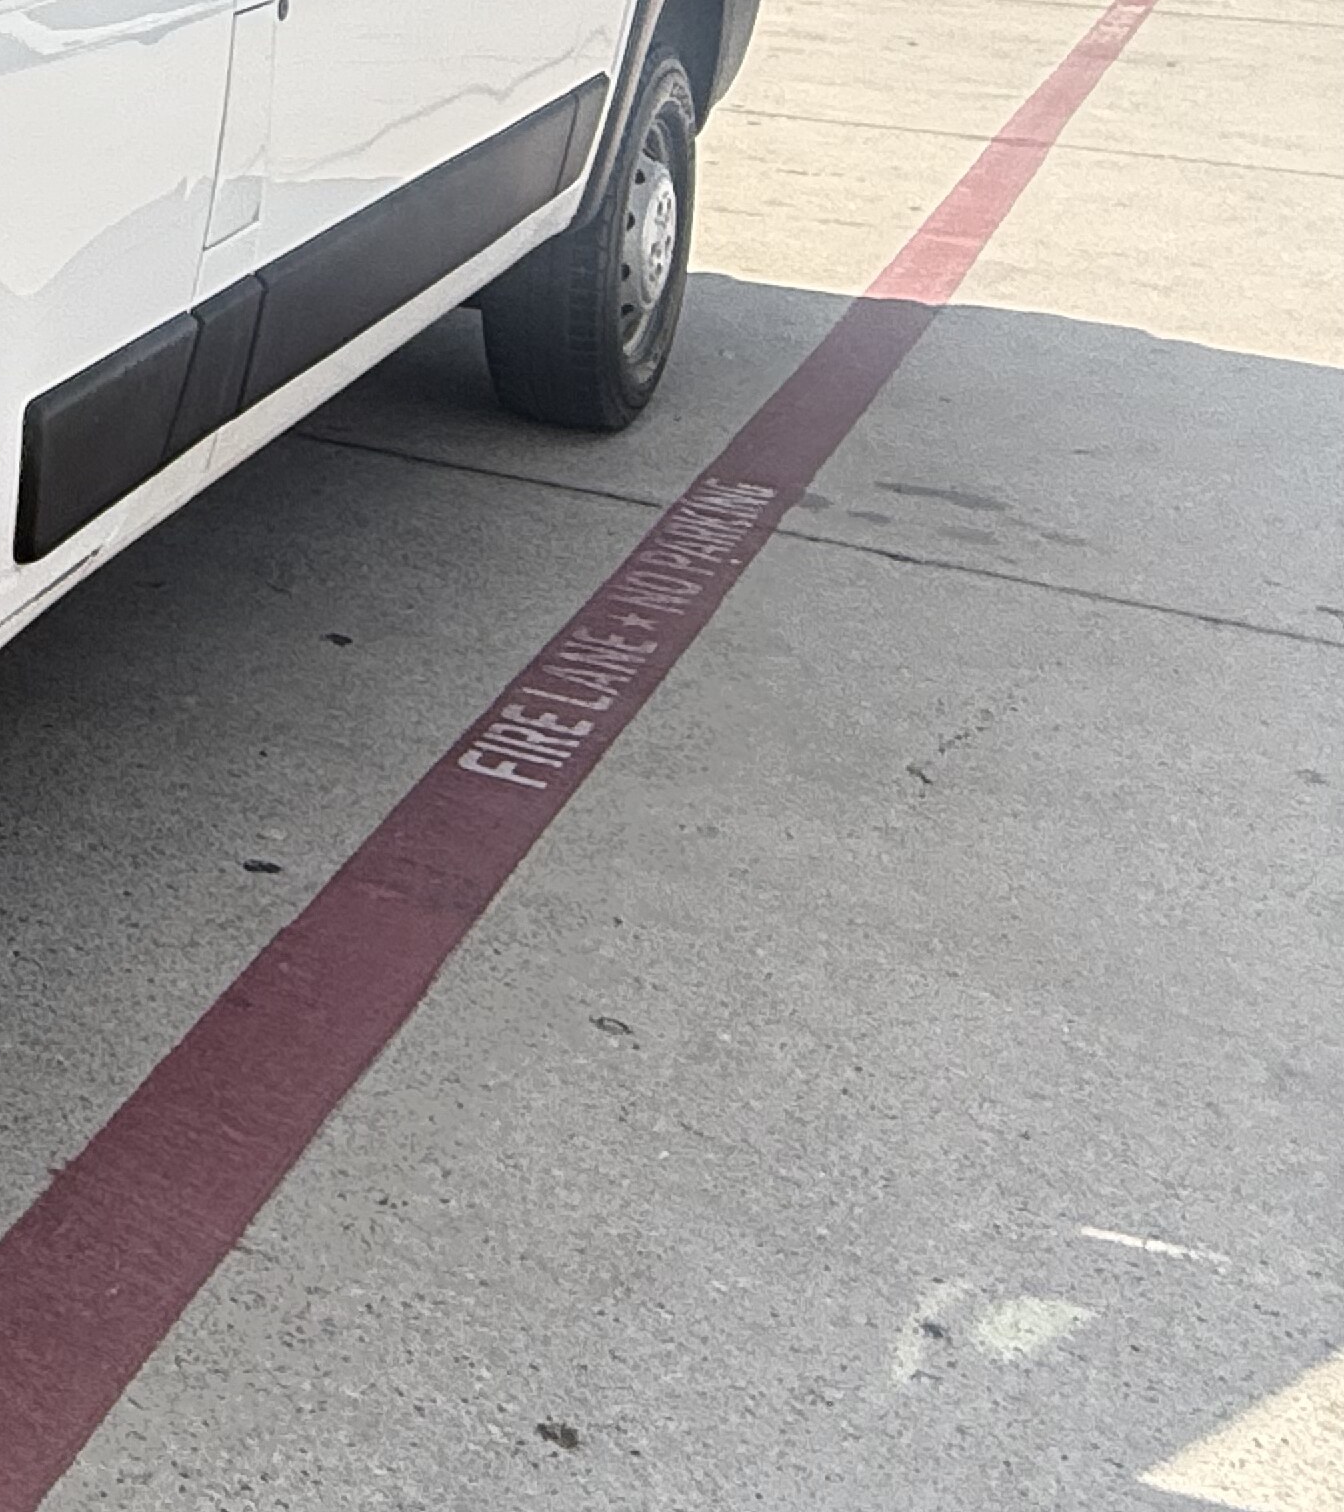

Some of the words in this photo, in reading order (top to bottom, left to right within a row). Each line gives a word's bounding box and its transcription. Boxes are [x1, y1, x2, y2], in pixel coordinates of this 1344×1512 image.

[637, 478, 777, 576] PARKING
[610, 568, 702, 615] NO
[522, 627, 658, 710] LANE
[458, 704, 592, 789] FIRE
